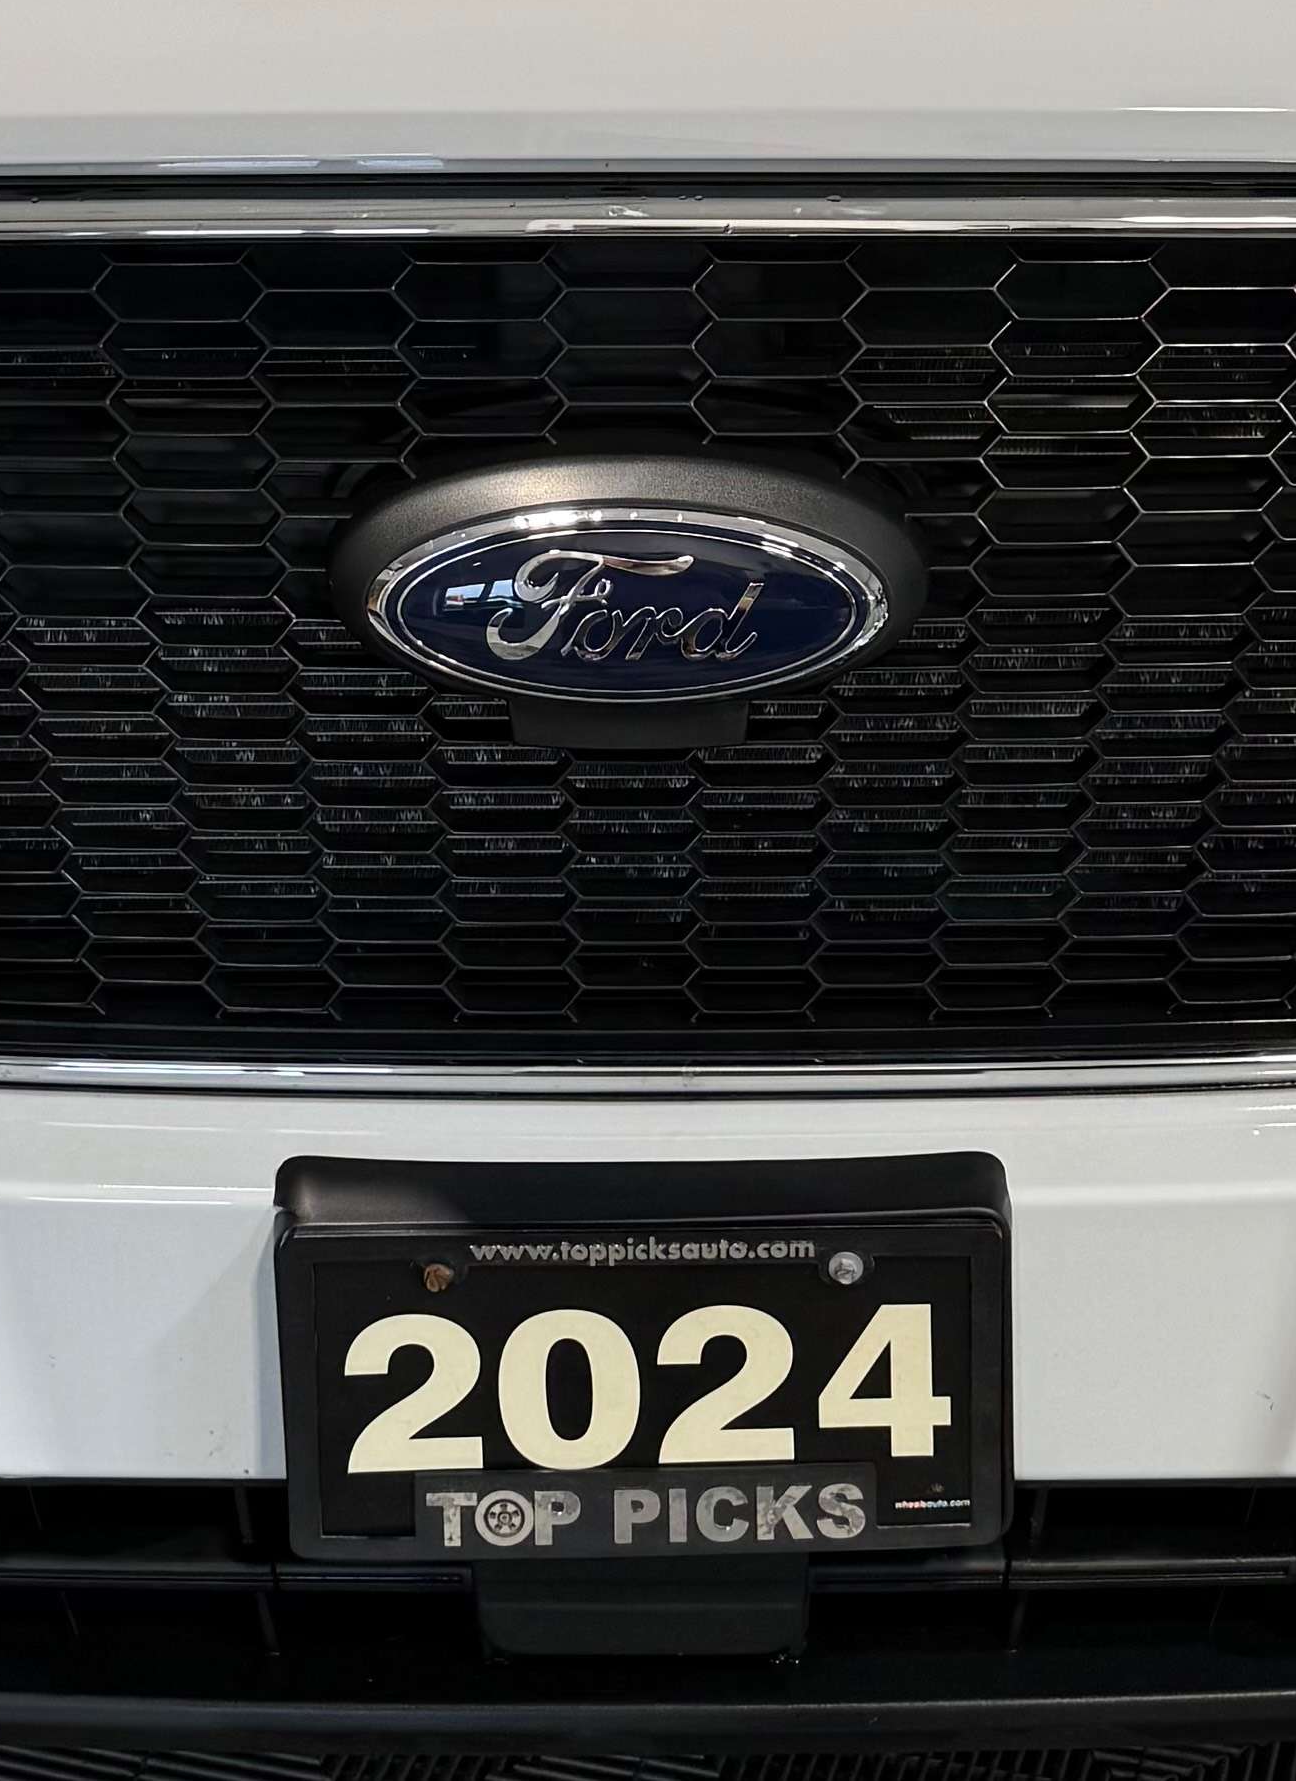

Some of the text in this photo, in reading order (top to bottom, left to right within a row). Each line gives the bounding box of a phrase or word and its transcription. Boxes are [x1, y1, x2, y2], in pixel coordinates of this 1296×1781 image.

[486, 548, 765, 661] Ford
[468, 1235, 816, 1266] www.toppicksauto.com
[344, 1303, 952, 1474] 2024
[425, 1483, 867, 1547] TOP PICKS
